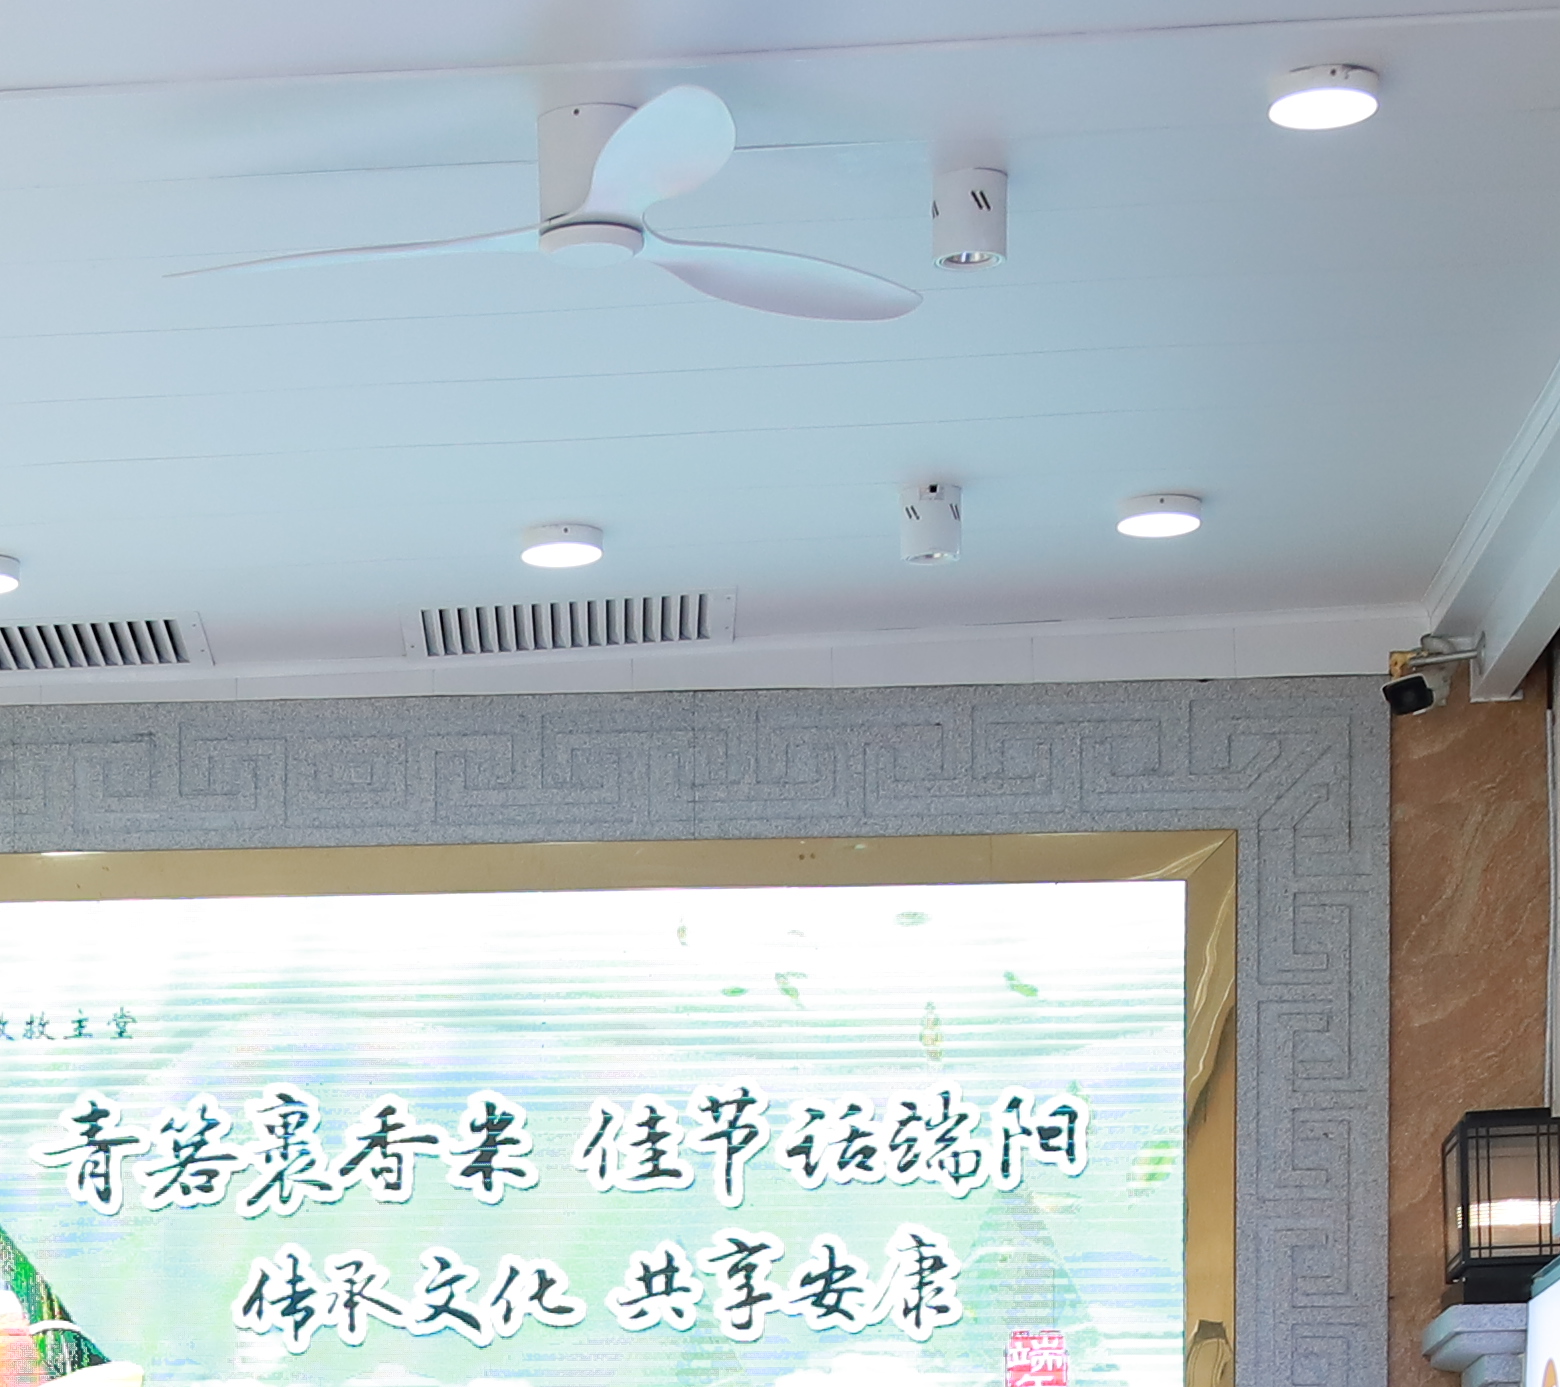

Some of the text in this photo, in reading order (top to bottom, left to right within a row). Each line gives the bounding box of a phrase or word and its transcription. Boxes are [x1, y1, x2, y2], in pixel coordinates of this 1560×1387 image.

[582, 1087, 1079, 1198] 佳节话端阳
[241, 1233, 951, 1343] 传承文化 共享安康
